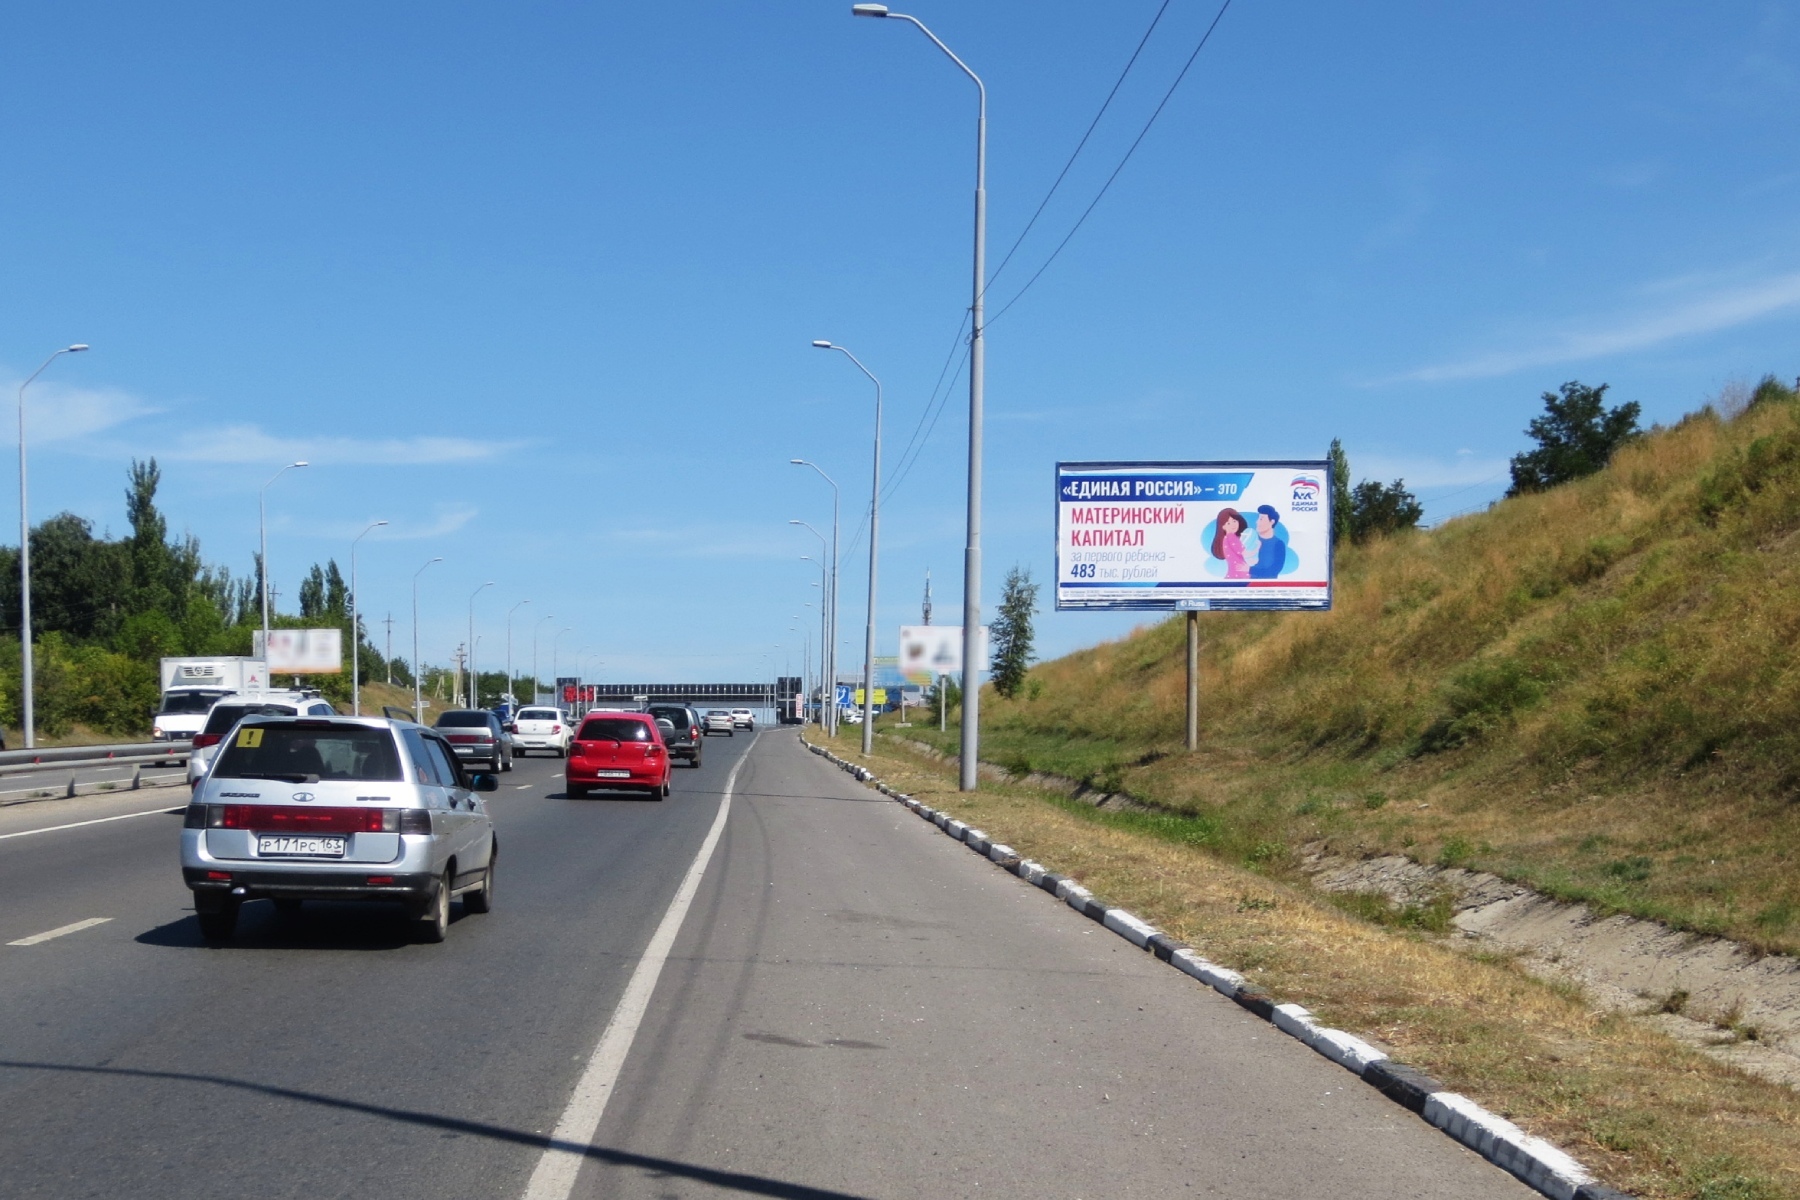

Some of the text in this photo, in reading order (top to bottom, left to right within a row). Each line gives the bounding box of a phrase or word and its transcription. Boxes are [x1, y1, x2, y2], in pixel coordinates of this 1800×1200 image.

[1063, 481, 1131, 497] «ЕДИНАЯ
[1135, 481, 1202, 497] РОССИЯ»
[1218, 484, 1237, 495] ЭТО
[1071, 503, 1185, 524] МАТЕРИНСКИЙ
[1071, 530, 1144, 547] КАПИТАЛ
[1070, 552, 1082, 562] за
[1084, 551, 1123, 564] первого
[1124, 548, 1166, 564] ребенка
[1070, 563, 1158, 580] 483 тыс. рублей
[319, 838, 338, 849] 163
